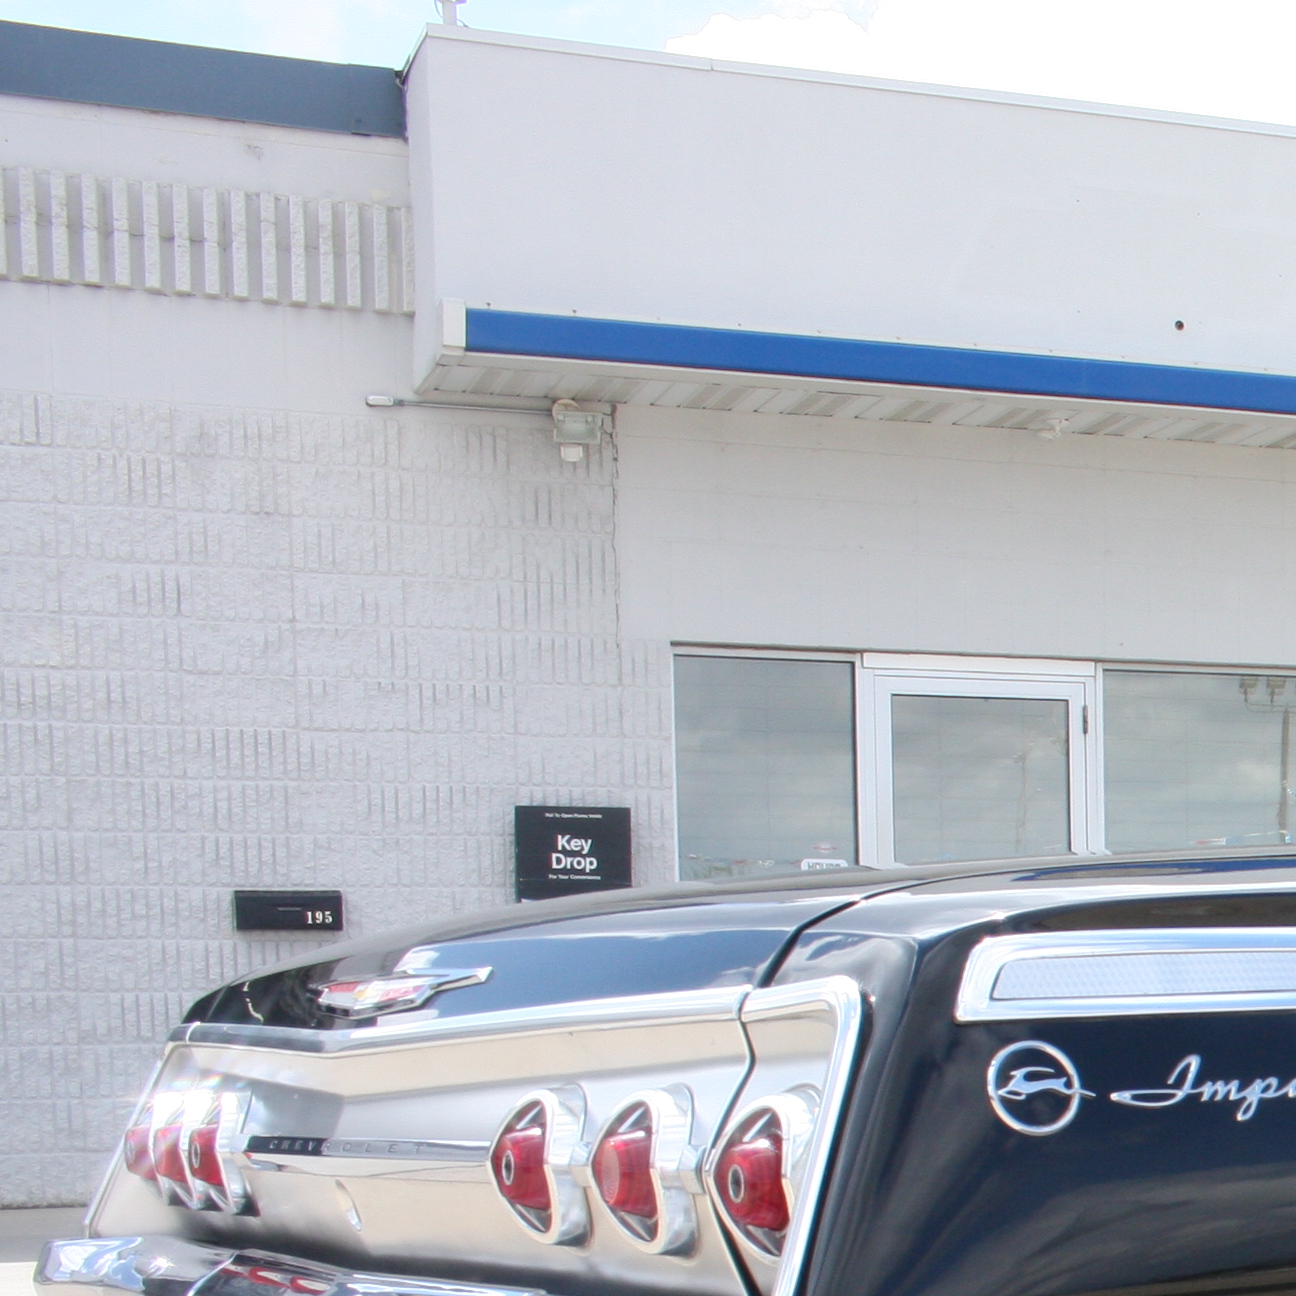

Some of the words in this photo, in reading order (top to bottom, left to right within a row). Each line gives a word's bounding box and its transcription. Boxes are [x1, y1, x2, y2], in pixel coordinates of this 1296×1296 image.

[557, 834, 592, 854] Key
[551, 853, 597, 873] Drop
[306, 911, 333, 924] 195
[269, 1139, 425, 1154] CHEVROLET
